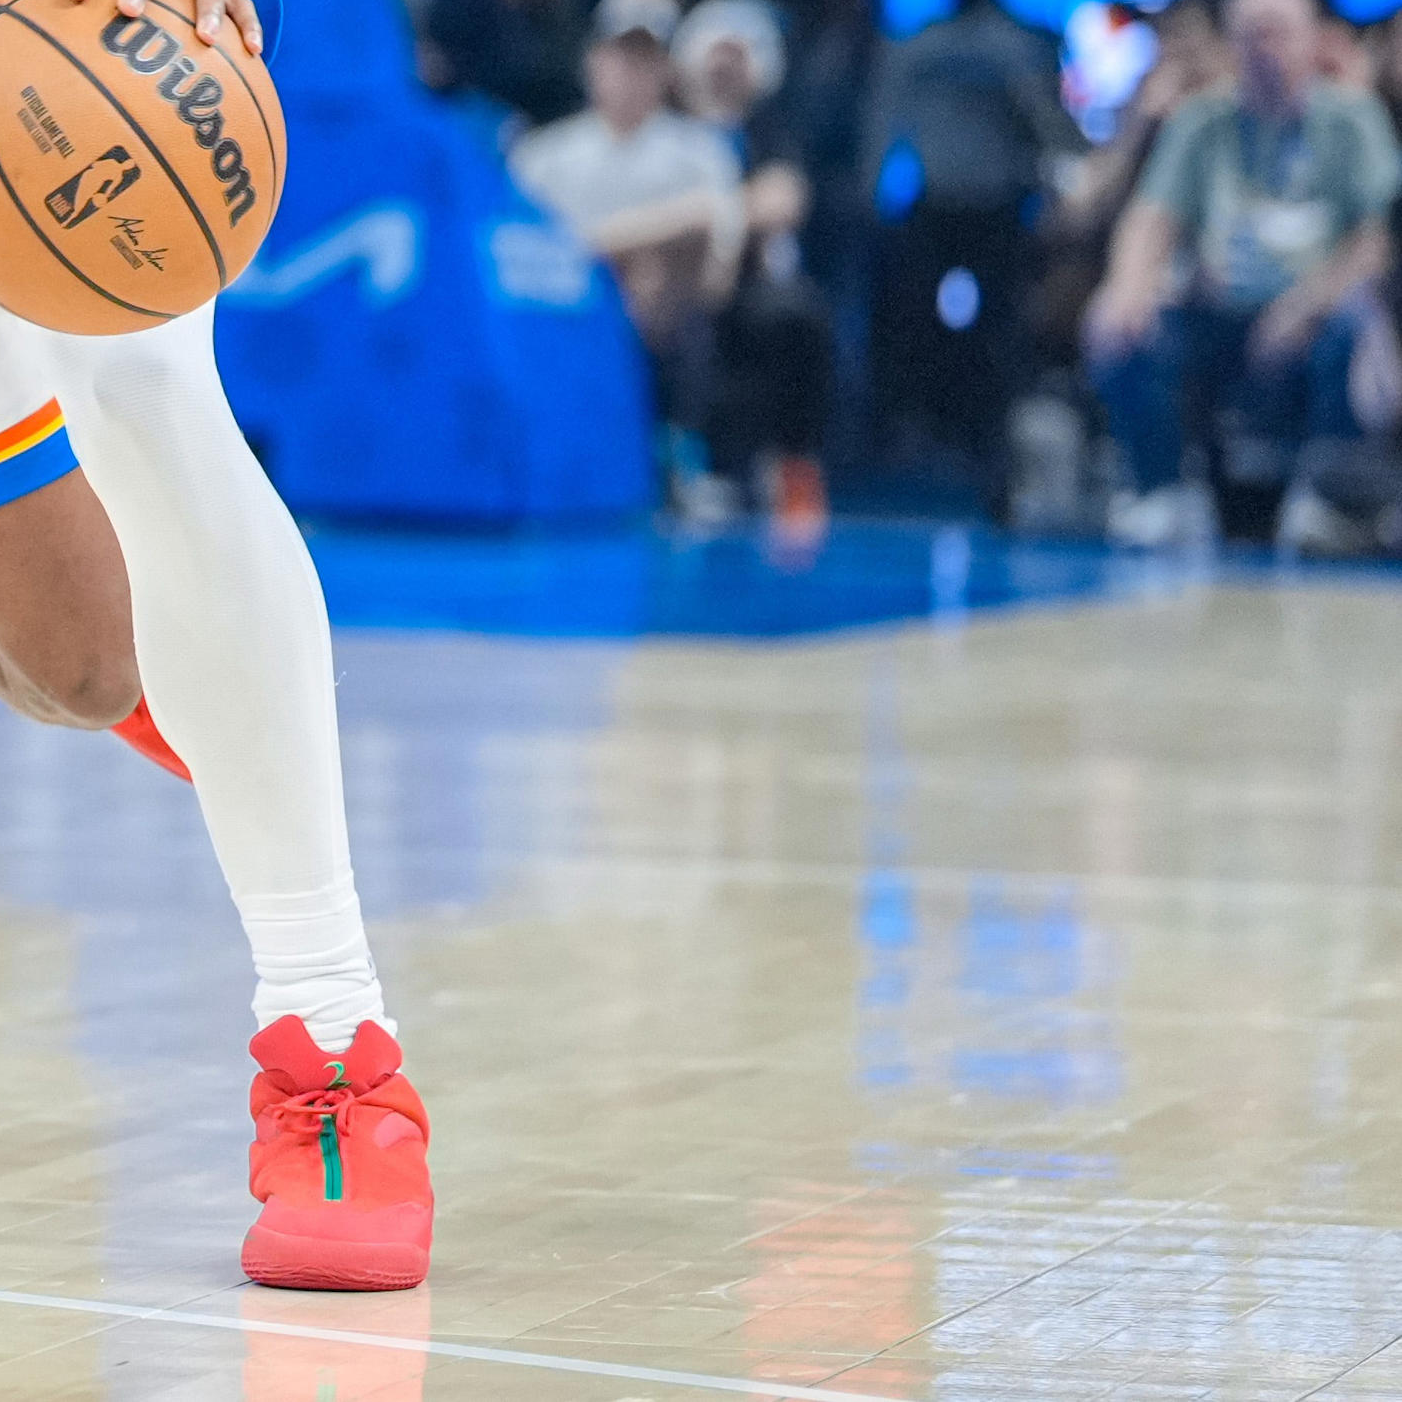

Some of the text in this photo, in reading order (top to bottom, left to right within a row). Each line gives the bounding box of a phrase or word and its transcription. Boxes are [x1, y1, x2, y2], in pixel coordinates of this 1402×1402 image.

[40, 115, 63, 141] GAME
[53, 136, 75, 159] BALL
[100, 13, 256, 229] Wilson
